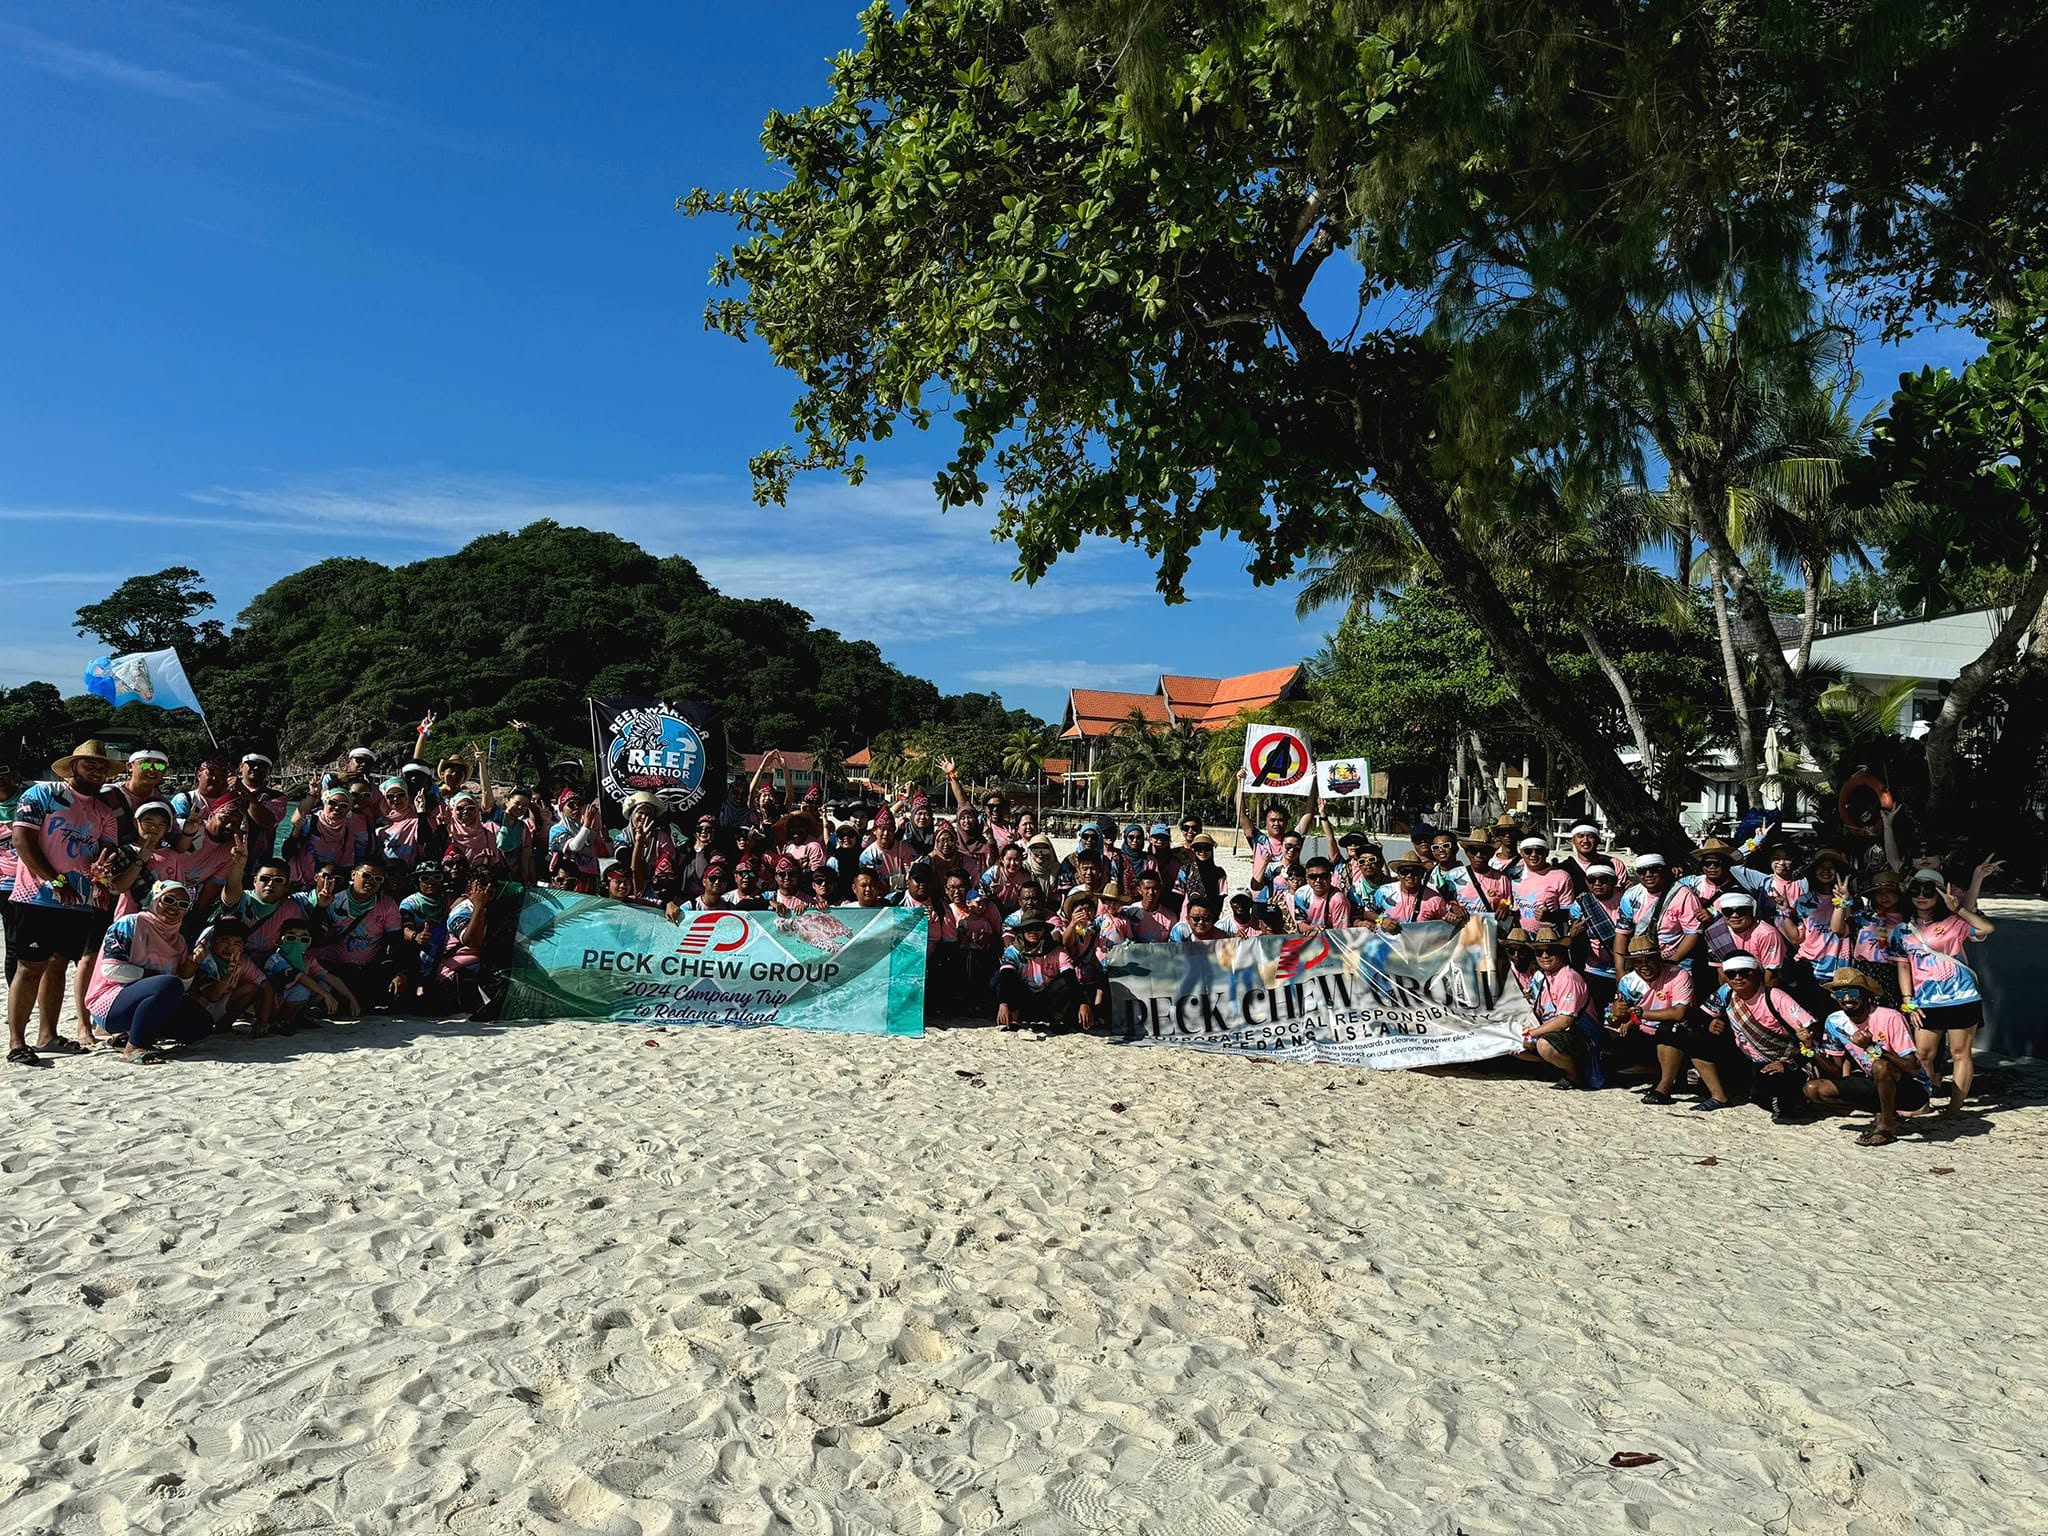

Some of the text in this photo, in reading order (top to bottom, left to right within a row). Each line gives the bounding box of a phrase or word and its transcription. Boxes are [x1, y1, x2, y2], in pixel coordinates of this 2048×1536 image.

[608, 708, 640, 735] REEF
[629, 749, 697, 770] REEF
[627, 764, 690, 779] WARRIOR
[679, 786, 706, 812] CARE
[581, 949, 840, 983] PECK CHEW GROUP
[623, 981, 787, 1008] 2024 Company Trip
[1122, 992, 1230, 1037] PECK
[1243, 973, 1354, 1026] CHEW
[633, 1003, 651, 1017] to
[724, 1007, 779, 1022] Island
[1334, 1022, 1428, 1042] ISLAND
[1355, 1040, 1384, 1049] towards
[1391, 1036, 1420, 1044] cleaner,
[1422, 1036, 1451, 1044] greener
